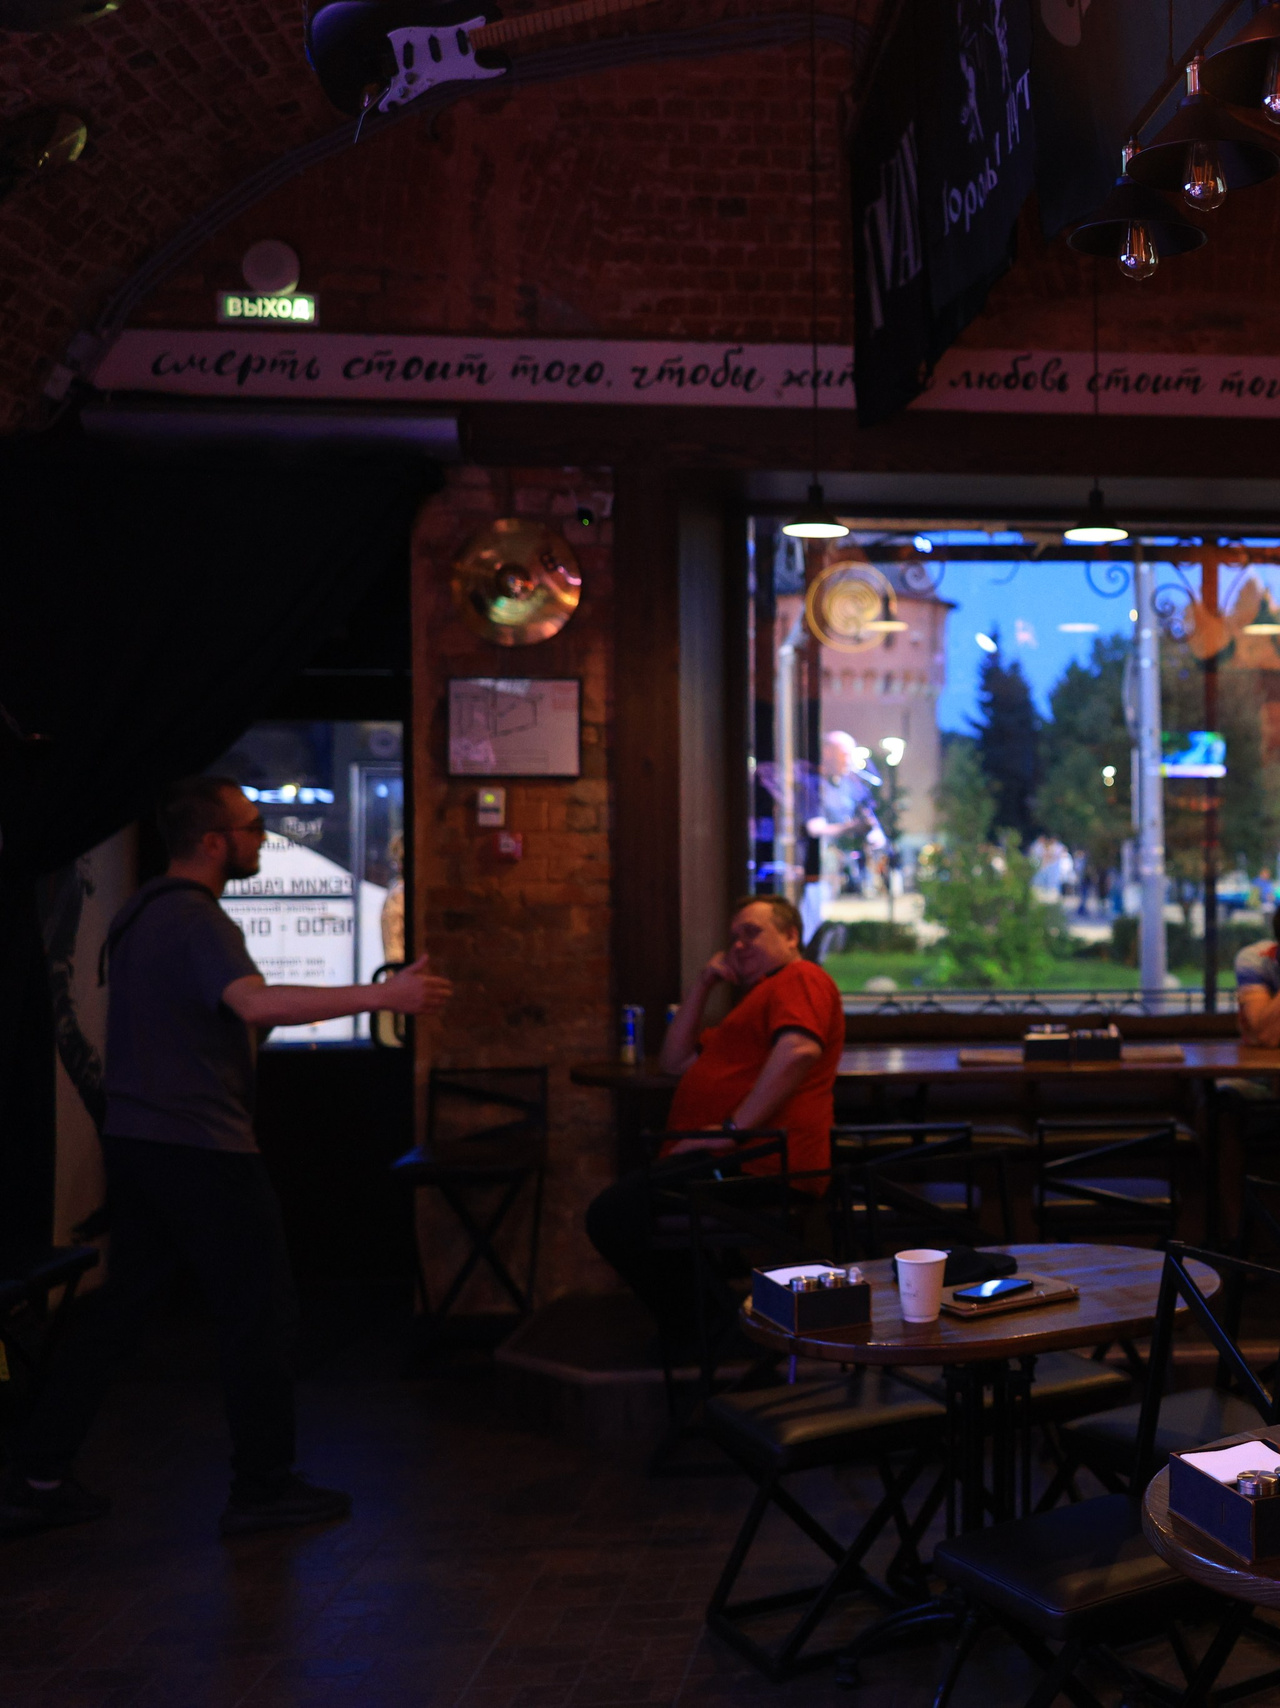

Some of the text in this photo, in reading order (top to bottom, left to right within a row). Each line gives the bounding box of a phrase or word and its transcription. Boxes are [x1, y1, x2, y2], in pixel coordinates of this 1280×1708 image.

[227, 296, 310, 320] ВЫХОД
[151, 349, 321, 386] смерть
[342, 350, 493, 384] стоит
[631, 346, 764, 392] чтобы
[949, 355, 1069, 392] любовь
[1086, 366, 1202, 394] стоит
